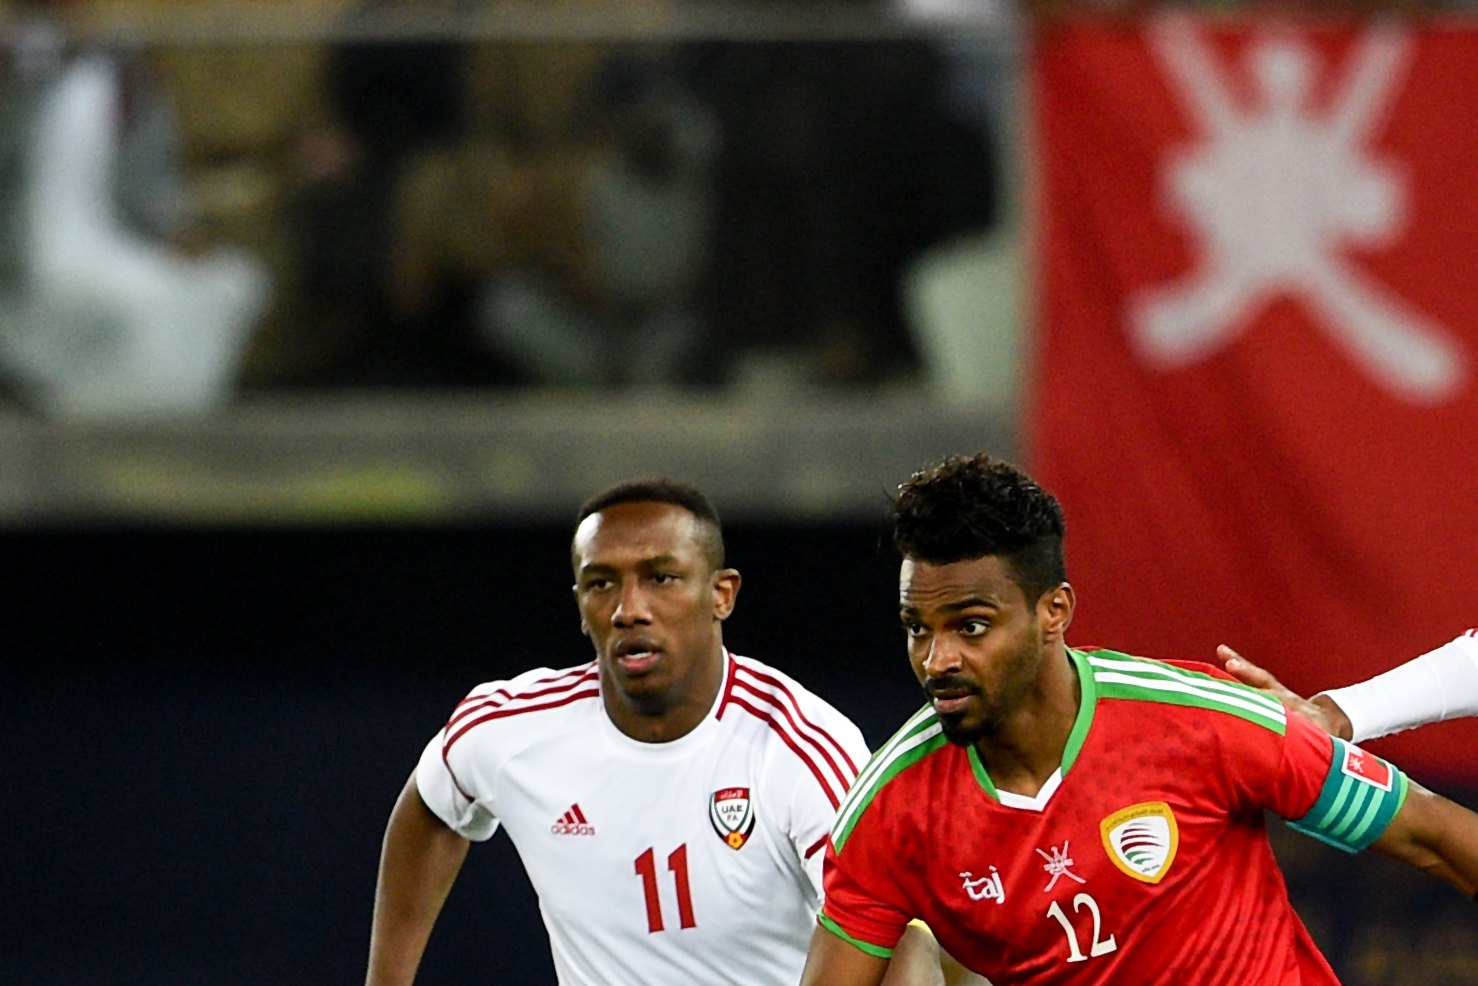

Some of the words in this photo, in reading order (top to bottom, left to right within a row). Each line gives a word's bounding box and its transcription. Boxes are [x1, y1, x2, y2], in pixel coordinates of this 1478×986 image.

[550, 825, 596, 836] adidas
[634, 842, 698, 935] 11
[959, 865, 1005, 904] taj
[1046, 892, 1118, 963] 12
